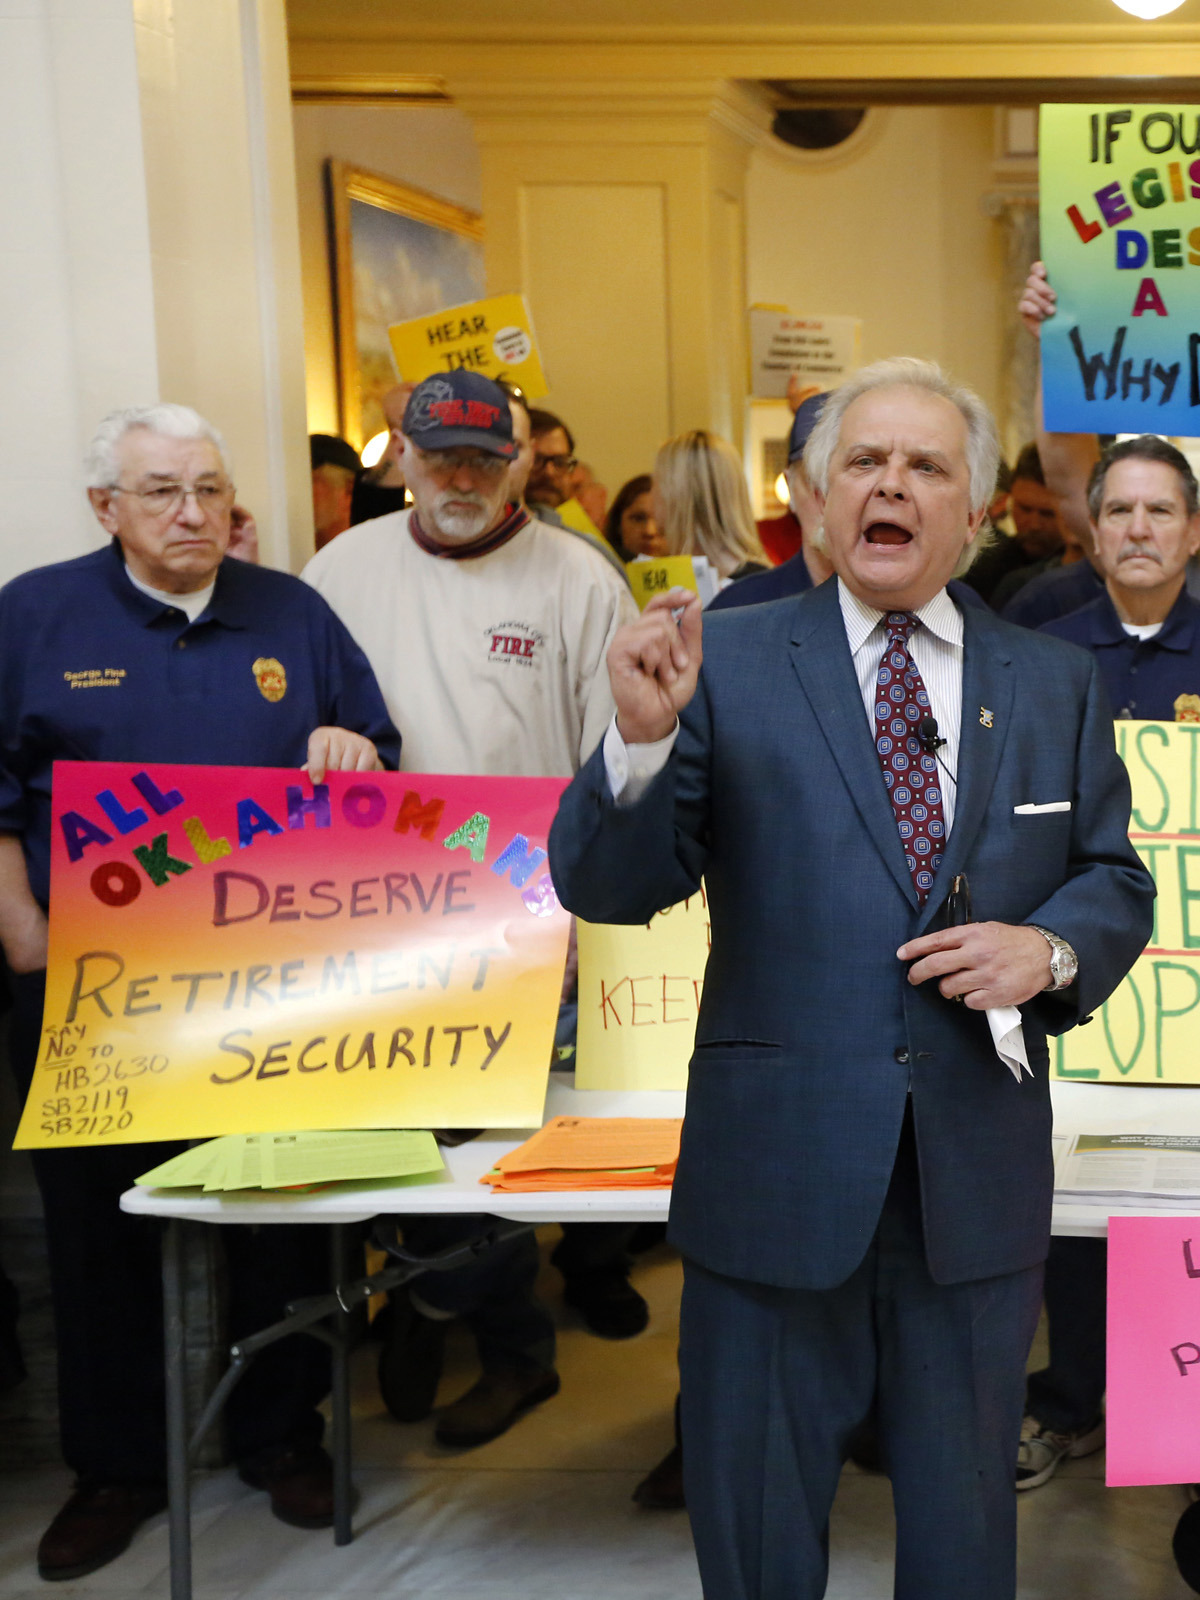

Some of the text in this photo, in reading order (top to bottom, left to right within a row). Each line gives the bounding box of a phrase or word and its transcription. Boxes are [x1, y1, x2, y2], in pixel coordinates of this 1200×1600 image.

[1090, 109, 1132, 163] IF
[1132, 277, 1168, 316] A
[427, 315, 489, 347] HEAR
[440, 345, 490, 372] THE
[489, 635, 535, 658] FIRE
[60, 771, 184, 863] ALL
[90, 784, 557, 918] OKLAHOMANS
[212, 869, 475, 928] DESERVE
[66, 947, 500, 1023] RETIREMENT
[210, 1022, 513, 1085] SECURITY
